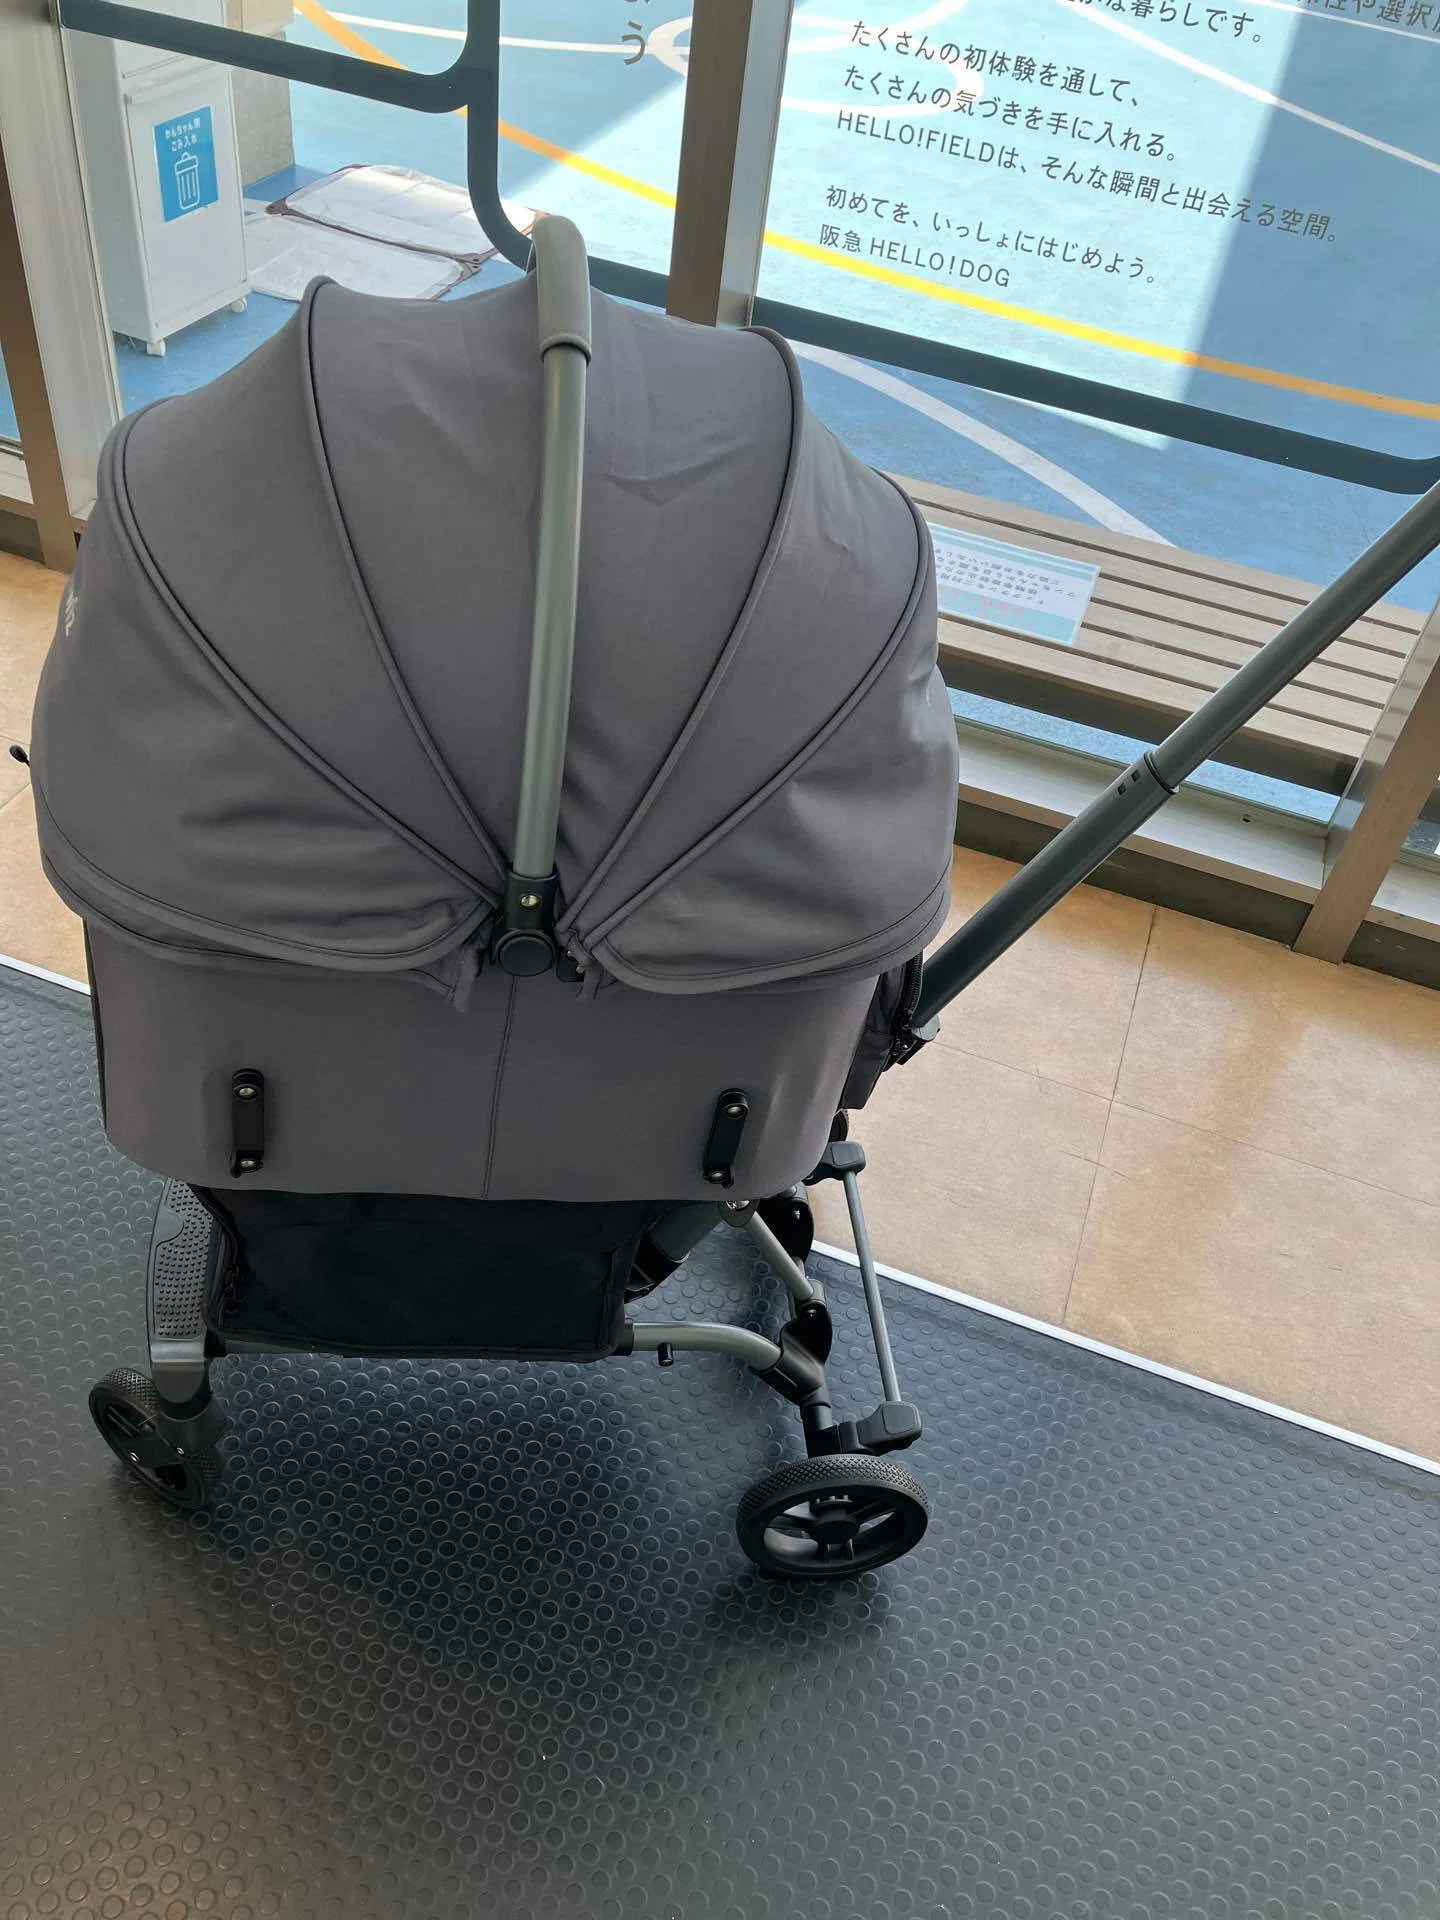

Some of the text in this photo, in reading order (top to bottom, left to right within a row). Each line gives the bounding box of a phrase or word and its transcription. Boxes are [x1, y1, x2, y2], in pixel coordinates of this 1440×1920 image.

[850, 20, 1139, 107] たくさんの初体験を通して、
[843, 65, 1175, 161] たくさんの気づきを手に入れる。
[819, 223, 1010, 288] 阪急 HELLO!DOG
